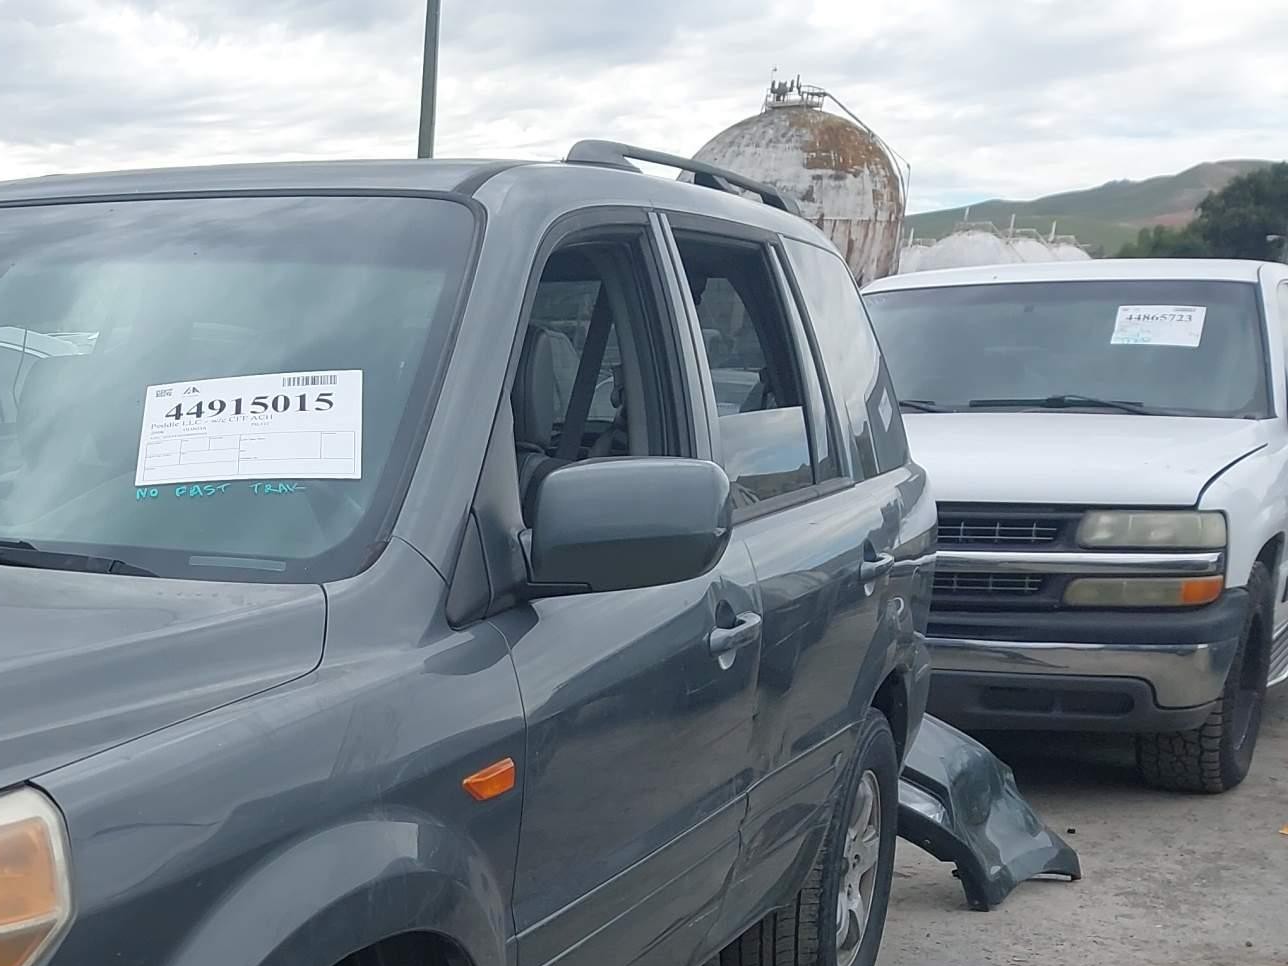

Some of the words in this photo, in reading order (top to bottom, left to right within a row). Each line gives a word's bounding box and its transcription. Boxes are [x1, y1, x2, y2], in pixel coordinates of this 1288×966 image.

[1126, 313, 1193, 322] 44865723
[165, 392, 334, 420] 44915015
[135, 487, 159, 500] NO
